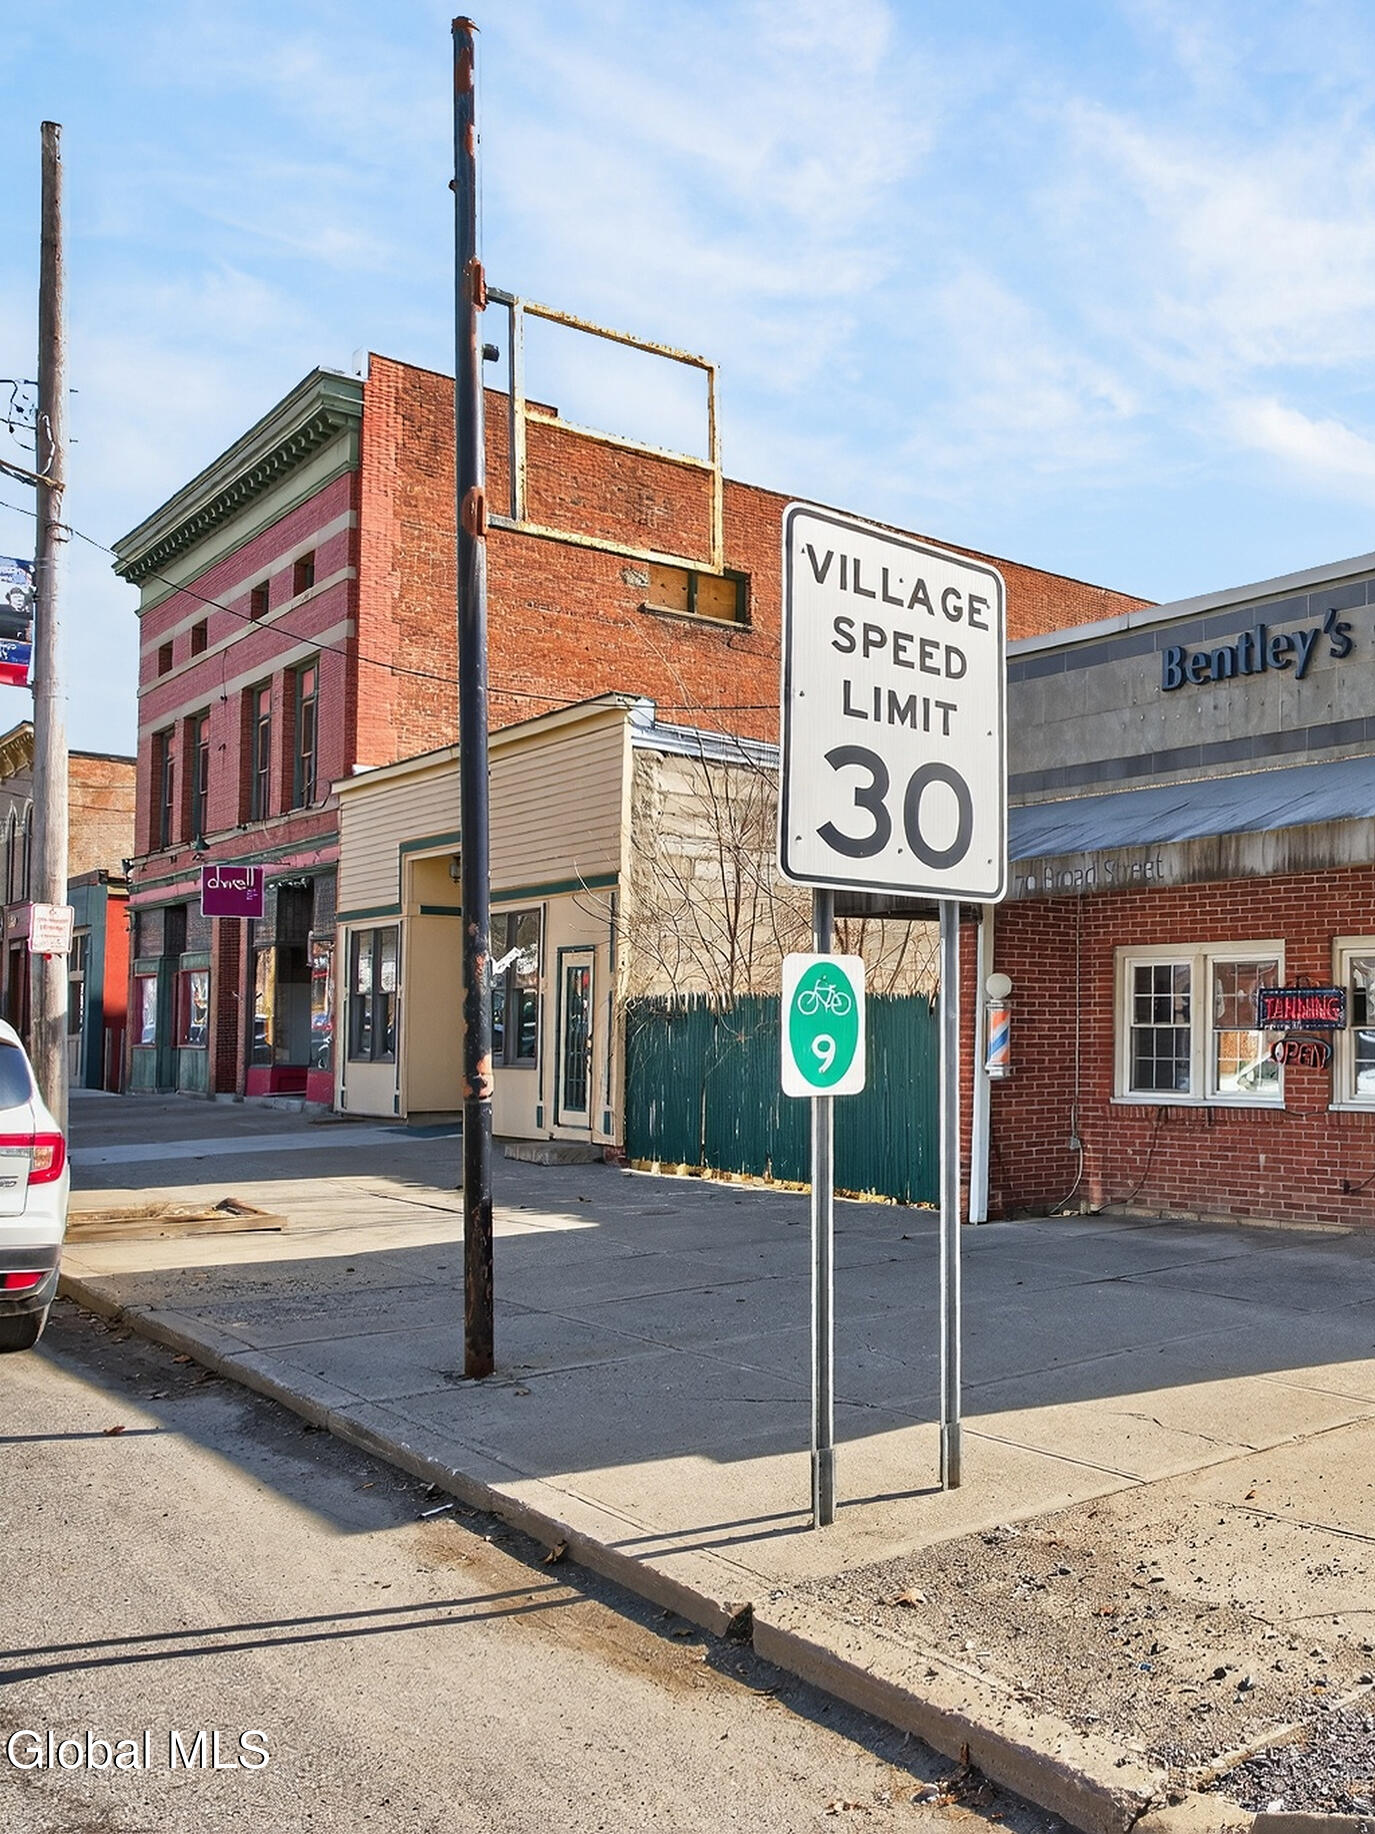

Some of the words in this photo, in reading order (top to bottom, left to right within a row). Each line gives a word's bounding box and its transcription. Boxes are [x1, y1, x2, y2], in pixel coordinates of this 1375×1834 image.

[806, 543, 989, 631] VILLAGE
[831, 615, 967, 680] SPEED
[1162, 608, 1353, 691] Bentley's
[843, 680, 957, 736] LIMIT
[816, 744, 973, 870] 30
[1015, 874, 1037, 898] 70
[1044, 862, 1097, 890] Broad
[1104, 850, 1165, 882] Street
[1264, 995, 1340, 1021] TANNING
[811, 1033, 837, 1074] 9
[1269, 1041, 1327, 1068] OPEN
